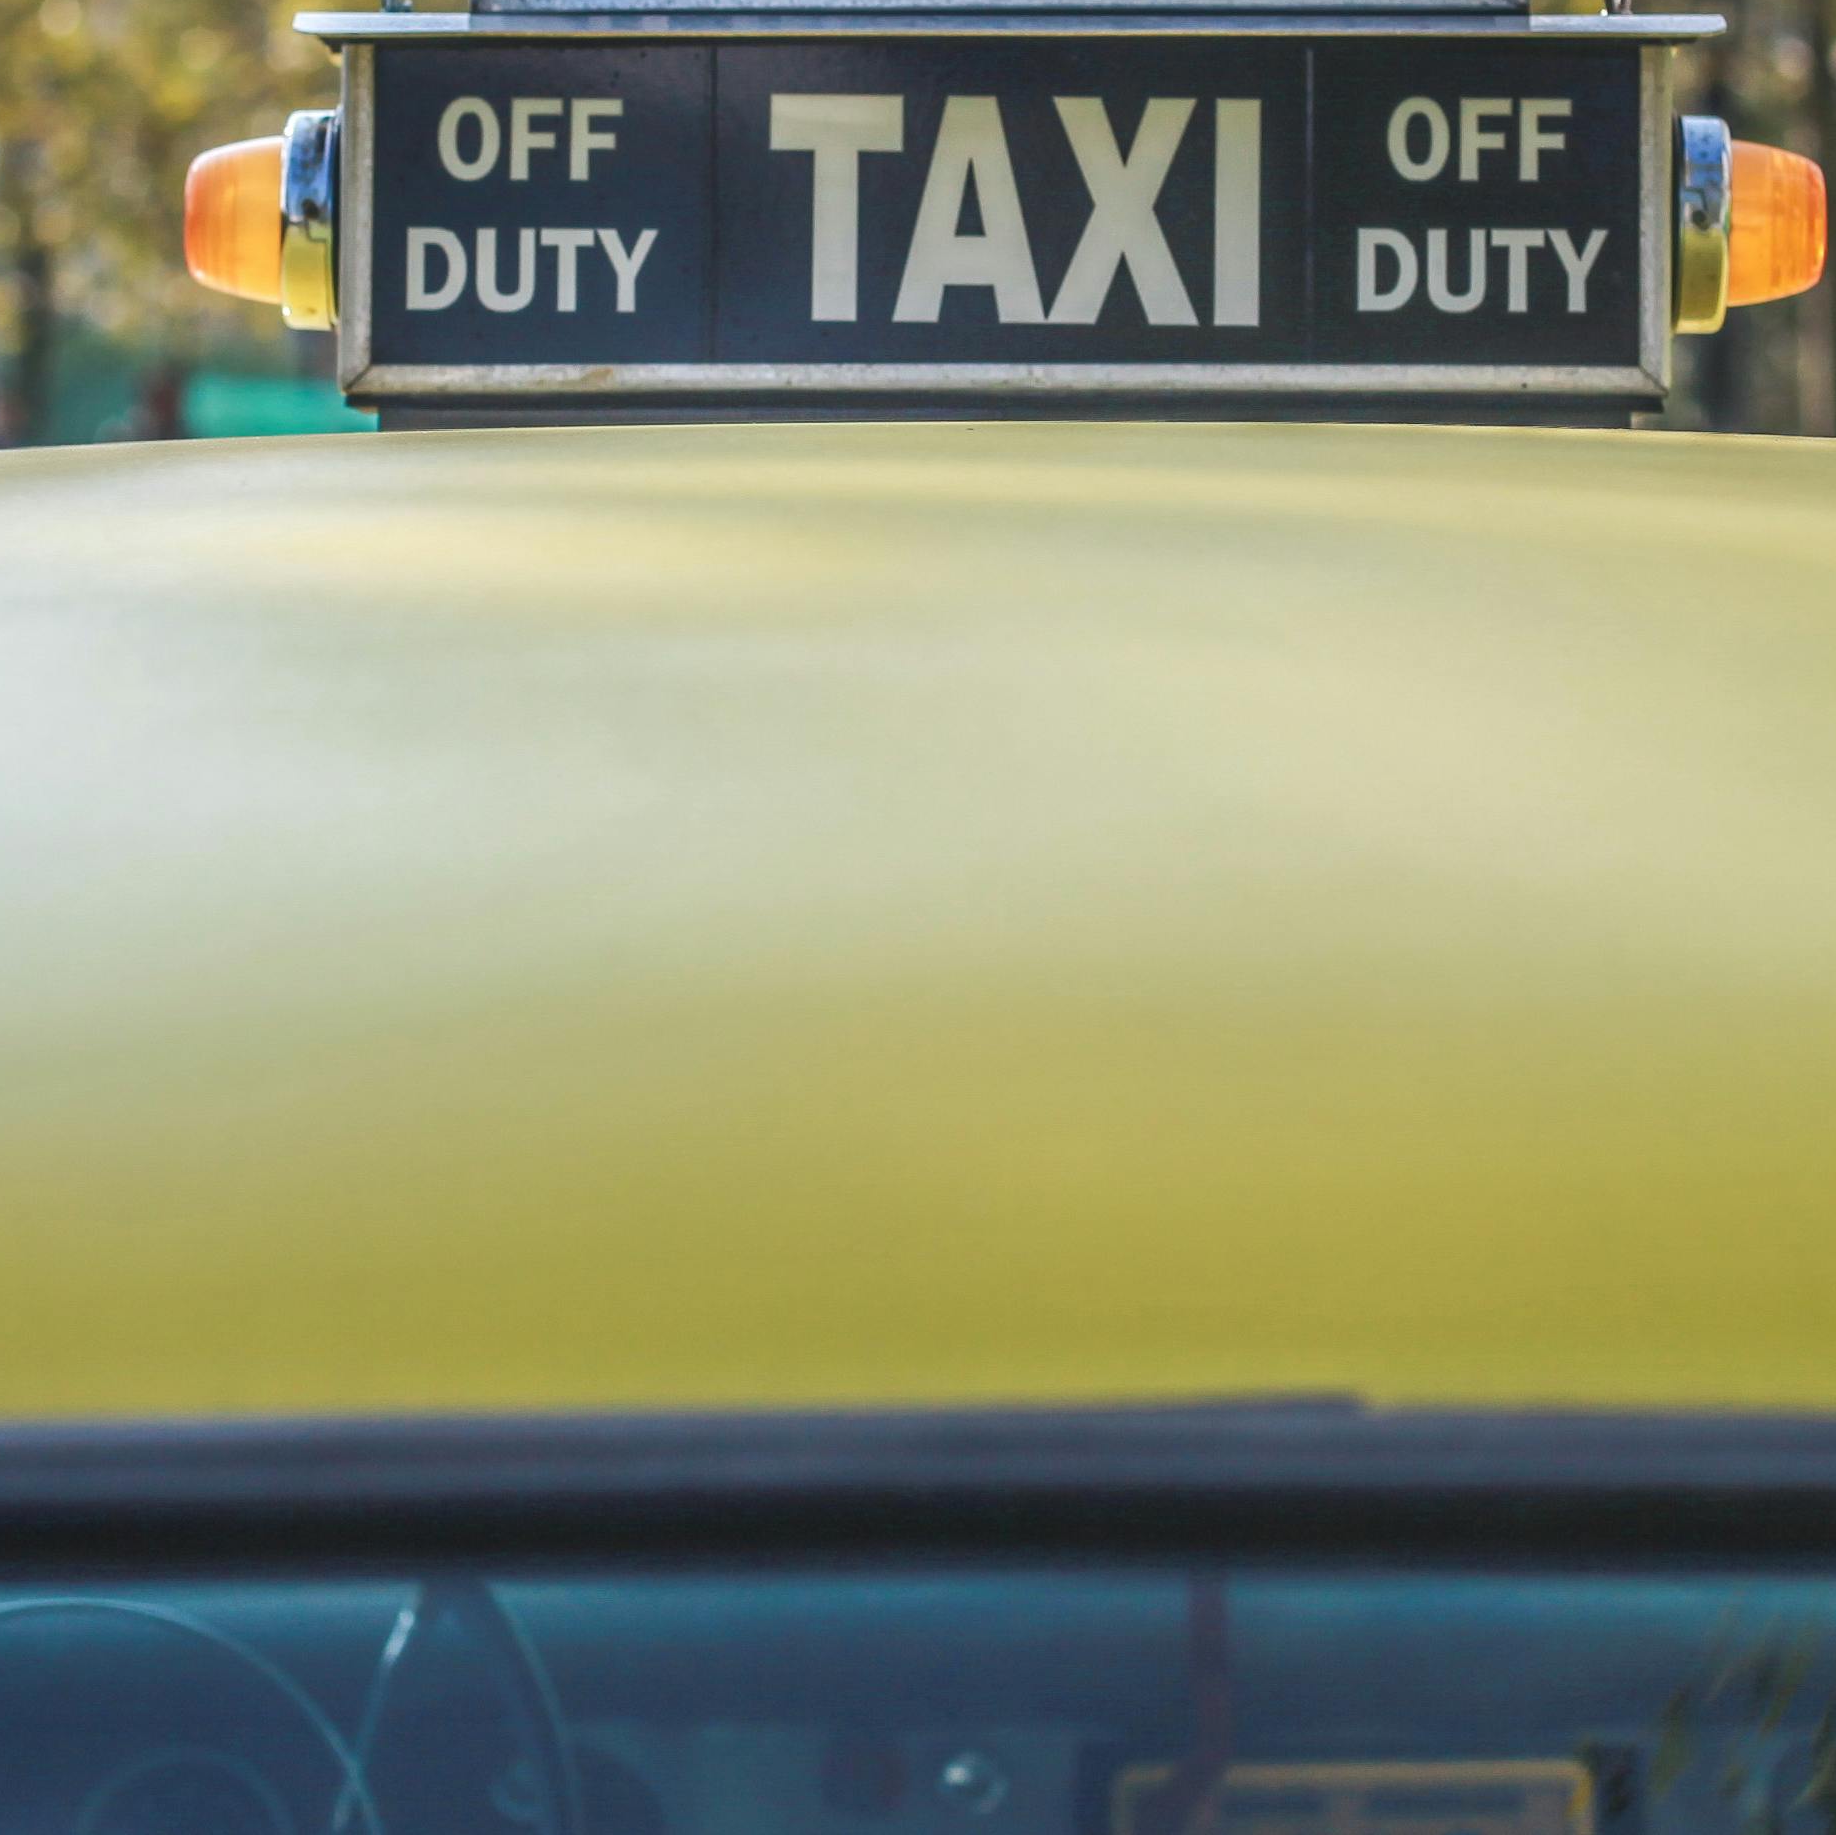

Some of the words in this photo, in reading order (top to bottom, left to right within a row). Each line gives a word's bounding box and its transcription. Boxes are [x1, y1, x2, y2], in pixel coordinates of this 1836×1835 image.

[438, 97, 623, 182] OFF
[1387, 96, 1572, 182] OFF
[769, 93, 1261, 327] TAXI
[406, 227, 658, 313] DUTY
[1356, 227, 1608, 314] DUTY
